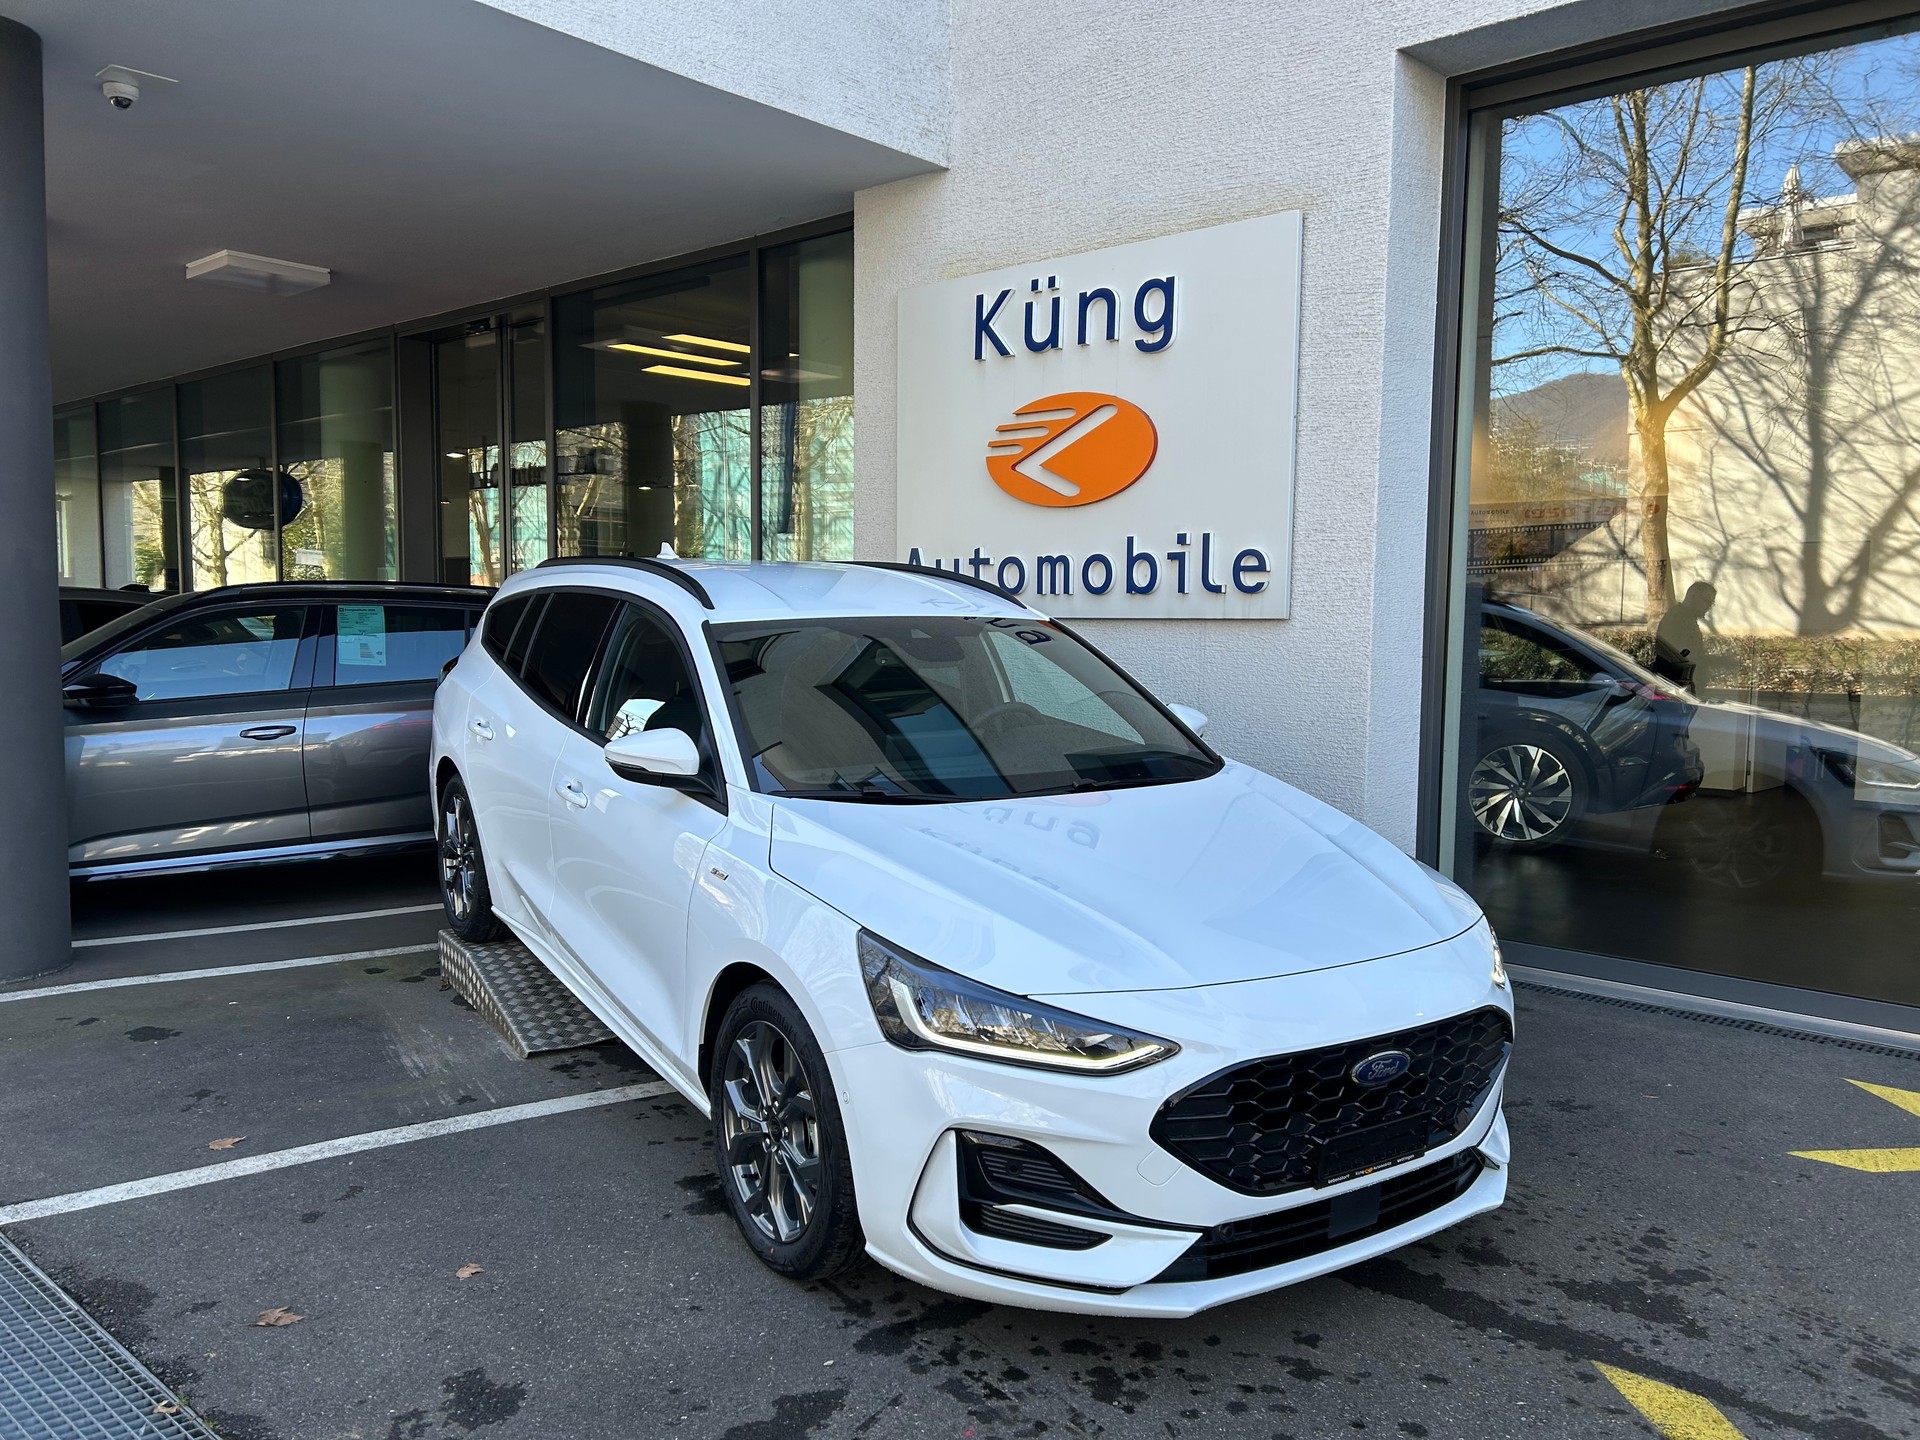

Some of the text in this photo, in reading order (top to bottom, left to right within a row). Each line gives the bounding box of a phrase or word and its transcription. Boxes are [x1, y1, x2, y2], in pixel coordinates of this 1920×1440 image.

[974, 275, 1177, 361] Küng
[750, 996, 794, 1034] Continental
[1367, 1059, 1400, 1080] Ford
